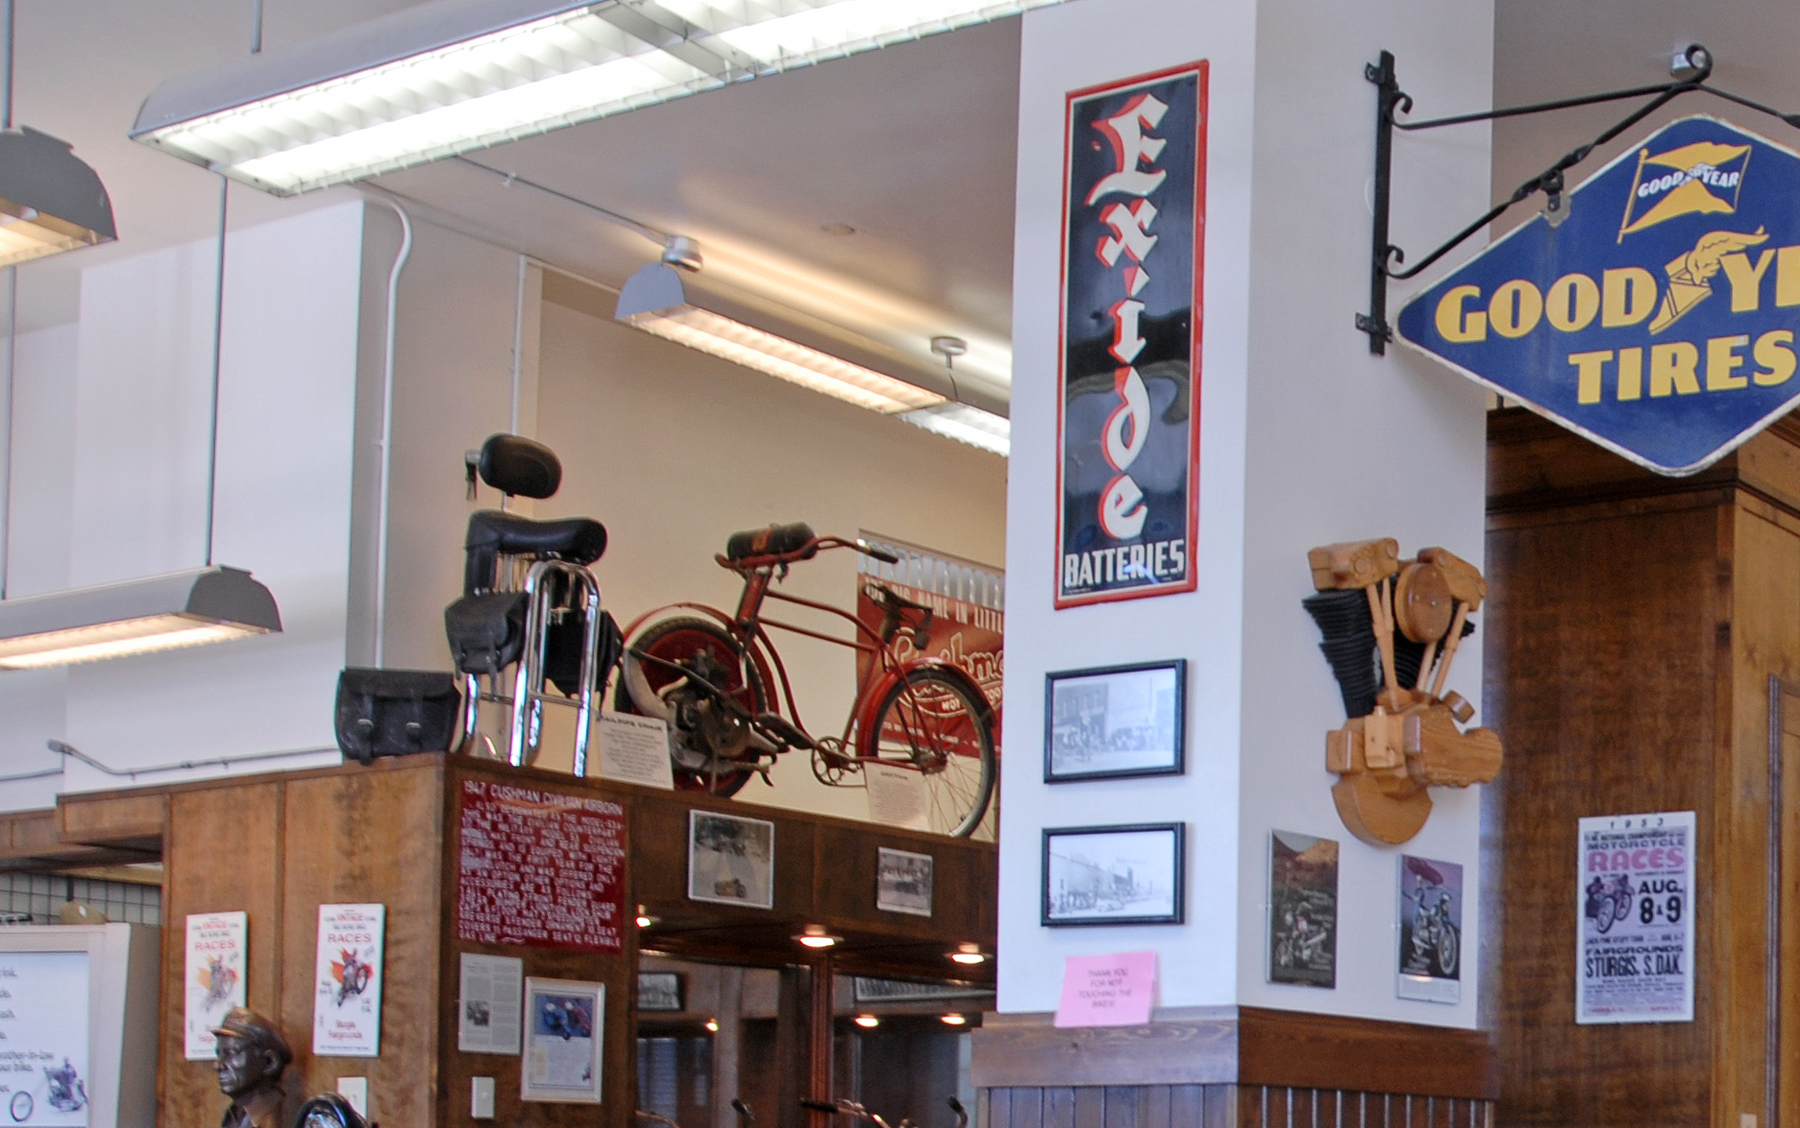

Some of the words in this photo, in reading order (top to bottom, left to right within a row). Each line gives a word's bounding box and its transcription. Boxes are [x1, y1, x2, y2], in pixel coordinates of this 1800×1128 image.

[1637, 170, 1684, 198] GOOD
[1702, 171, 1740, 187] YEAR
[1084, 93, 1169, 539] Exide
[1434, 265, 1658, 343] GOOD
[1568, 330, 1798, 405] TIRES
[1065, 539, 1185, 588] BATTERIES
[956, 602, 968, 625] IN
[974, 605, 1002, 634] LITTL
[490, 785, 539, 803] CUSHMAN
[1587, 838, 1685, 850] MOTORCYCLE
[1588, 847, 1684, 872] RACES
[1639, 880, 1683, 894] AUG.
[1640, 897, 1654, 924] 8
[1667, 895, 1681, 923] 9
[194, 939, 236, 951] RACES
[327, 933, 372, 943] RACES
[1586, 945, 1683, 956] FAIRGROUNDS
[1656, 954, 1683, 975] DAK.
